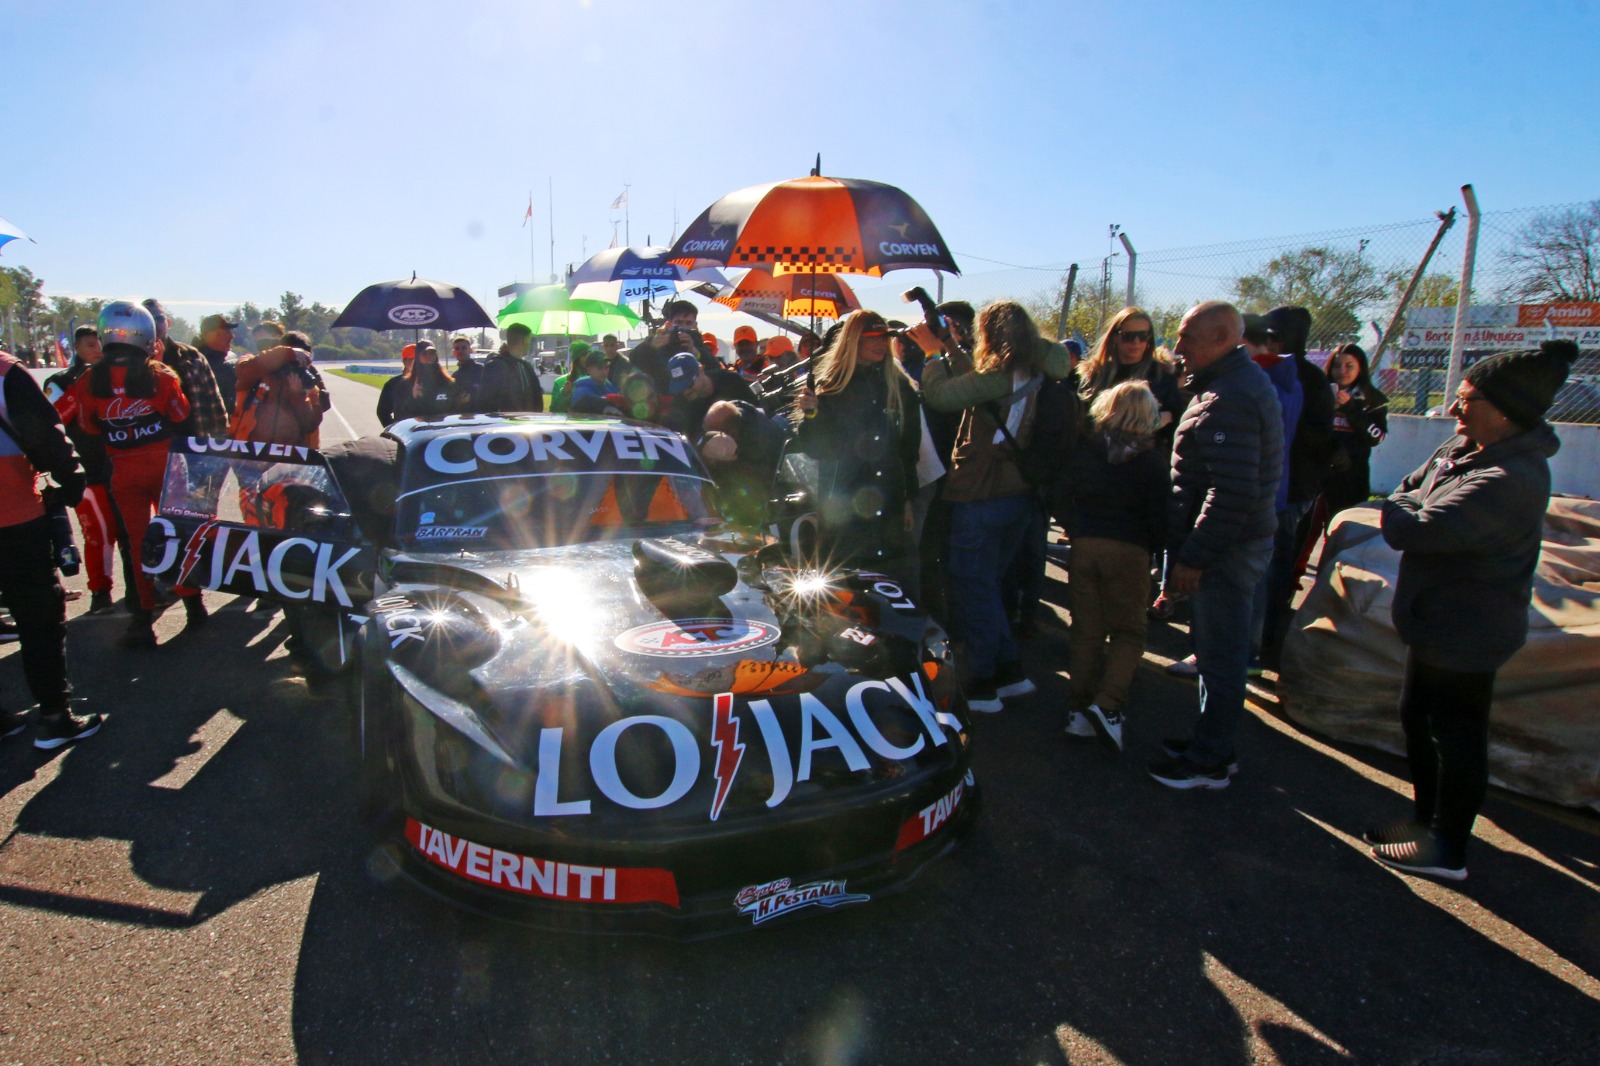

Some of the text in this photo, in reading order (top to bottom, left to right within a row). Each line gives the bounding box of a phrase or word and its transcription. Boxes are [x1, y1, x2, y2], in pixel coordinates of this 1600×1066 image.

[682, 239, 729, 253] CORVEN
[879, 241, 940, 256] CORVEN
[642, 267, 673, 276] RUS
[424, 429, 692, 475] CORVEN
[419, 823, 616, 900] TAVERNITI
